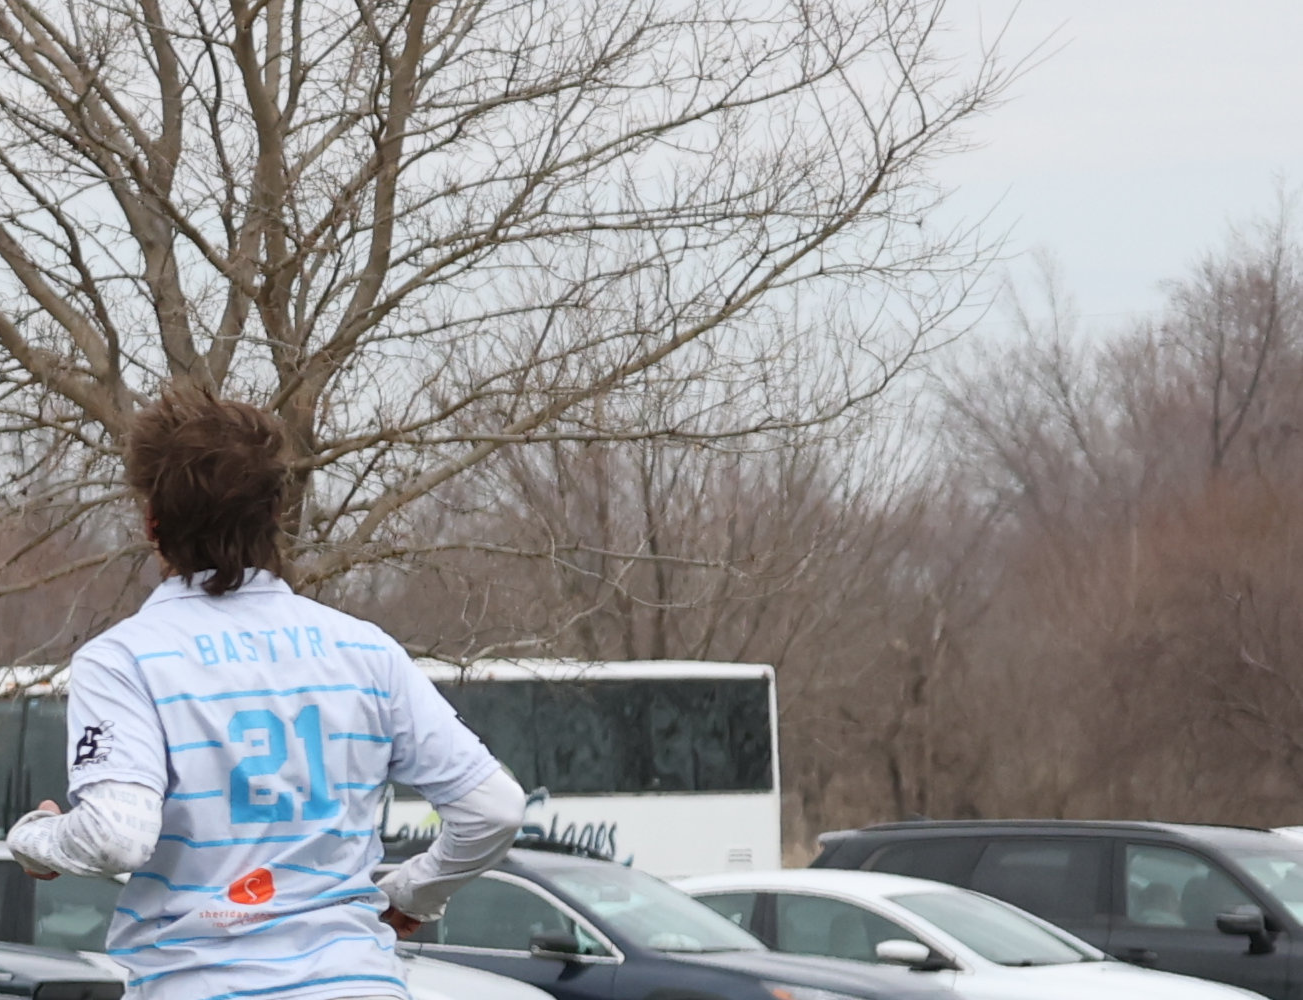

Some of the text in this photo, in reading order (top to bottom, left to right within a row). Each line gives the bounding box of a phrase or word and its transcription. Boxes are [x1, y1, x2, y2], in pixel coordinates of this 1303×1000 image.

[194, 625, 327, 667] BASTYR
[229, 704, 341, 825] 21
[199, 909, 250, 919] sheridan
